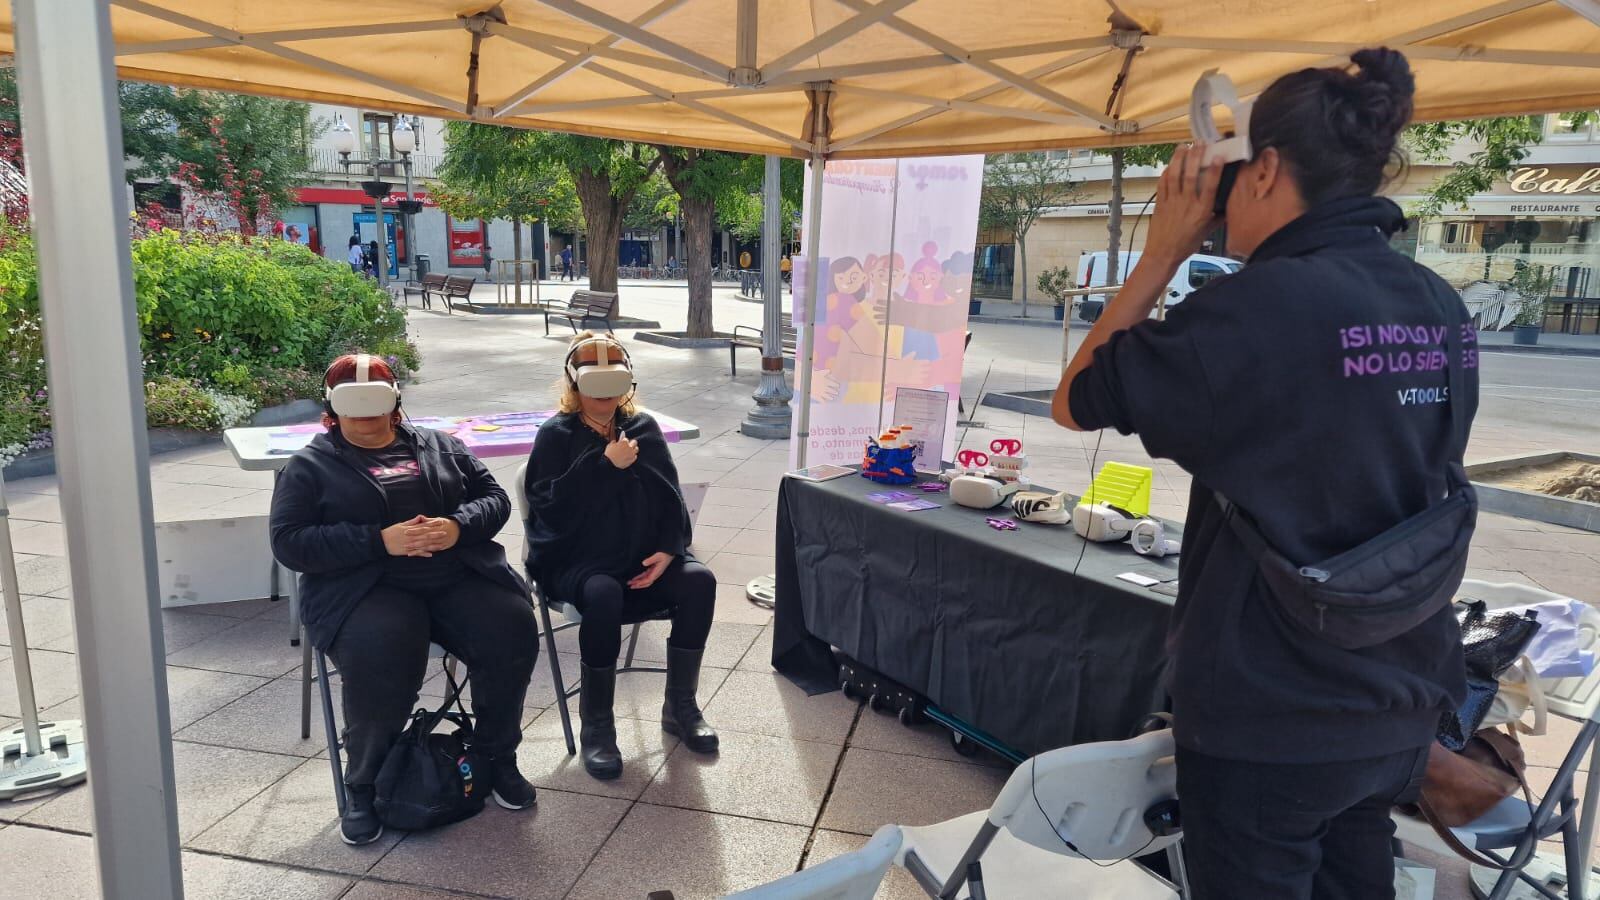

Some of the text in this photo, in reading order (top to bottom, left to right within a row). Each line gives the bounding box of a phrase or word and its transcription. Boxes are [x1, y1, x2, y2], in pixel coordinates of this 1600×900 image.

[1378, 324, 1406, 345] NO
[1344, 353, 1384, 378] NO
[1388, 351, 1412, 373] LO
